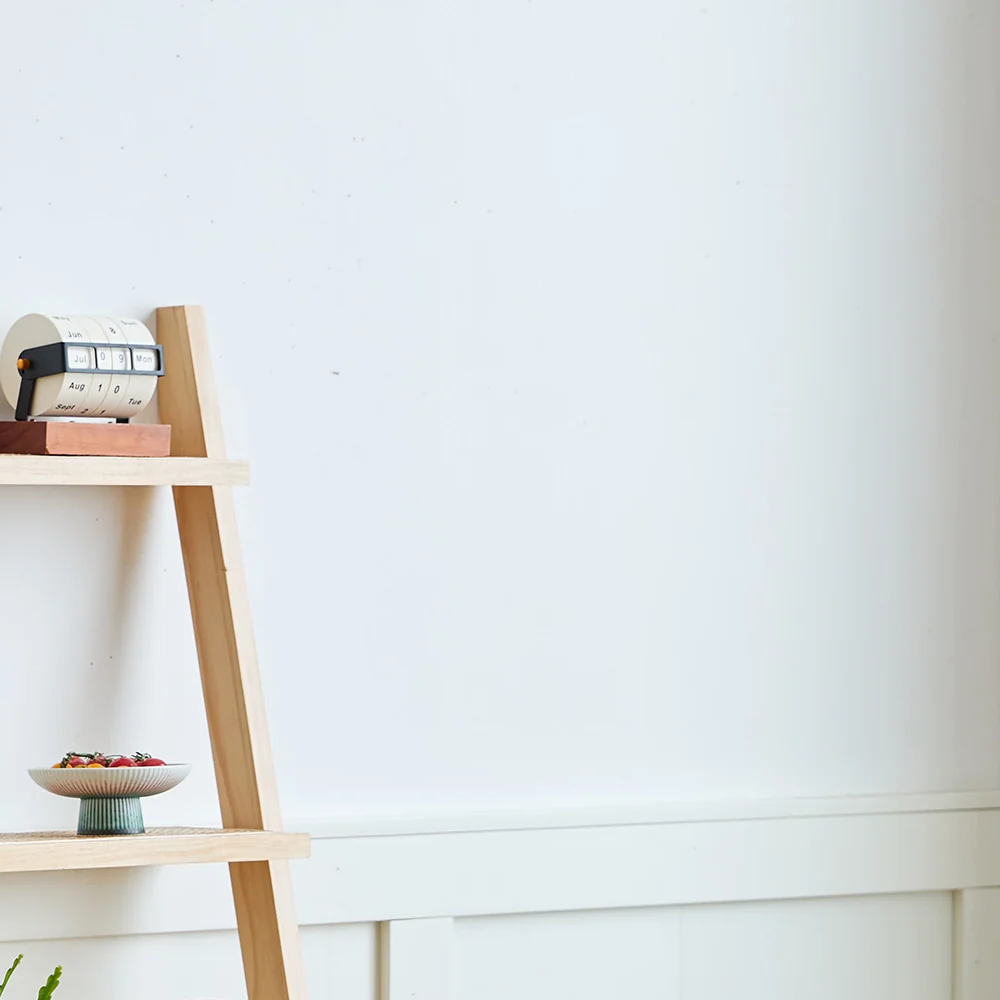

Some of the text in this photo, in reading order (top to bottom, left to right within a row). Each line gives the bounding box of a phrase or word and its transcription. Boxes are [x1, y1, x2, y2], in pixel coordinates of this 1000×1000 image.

[74, 355, 87, 363] Jul
[136, 355, 153, 363] Mon
[68, 382, 85, 391] Aug
